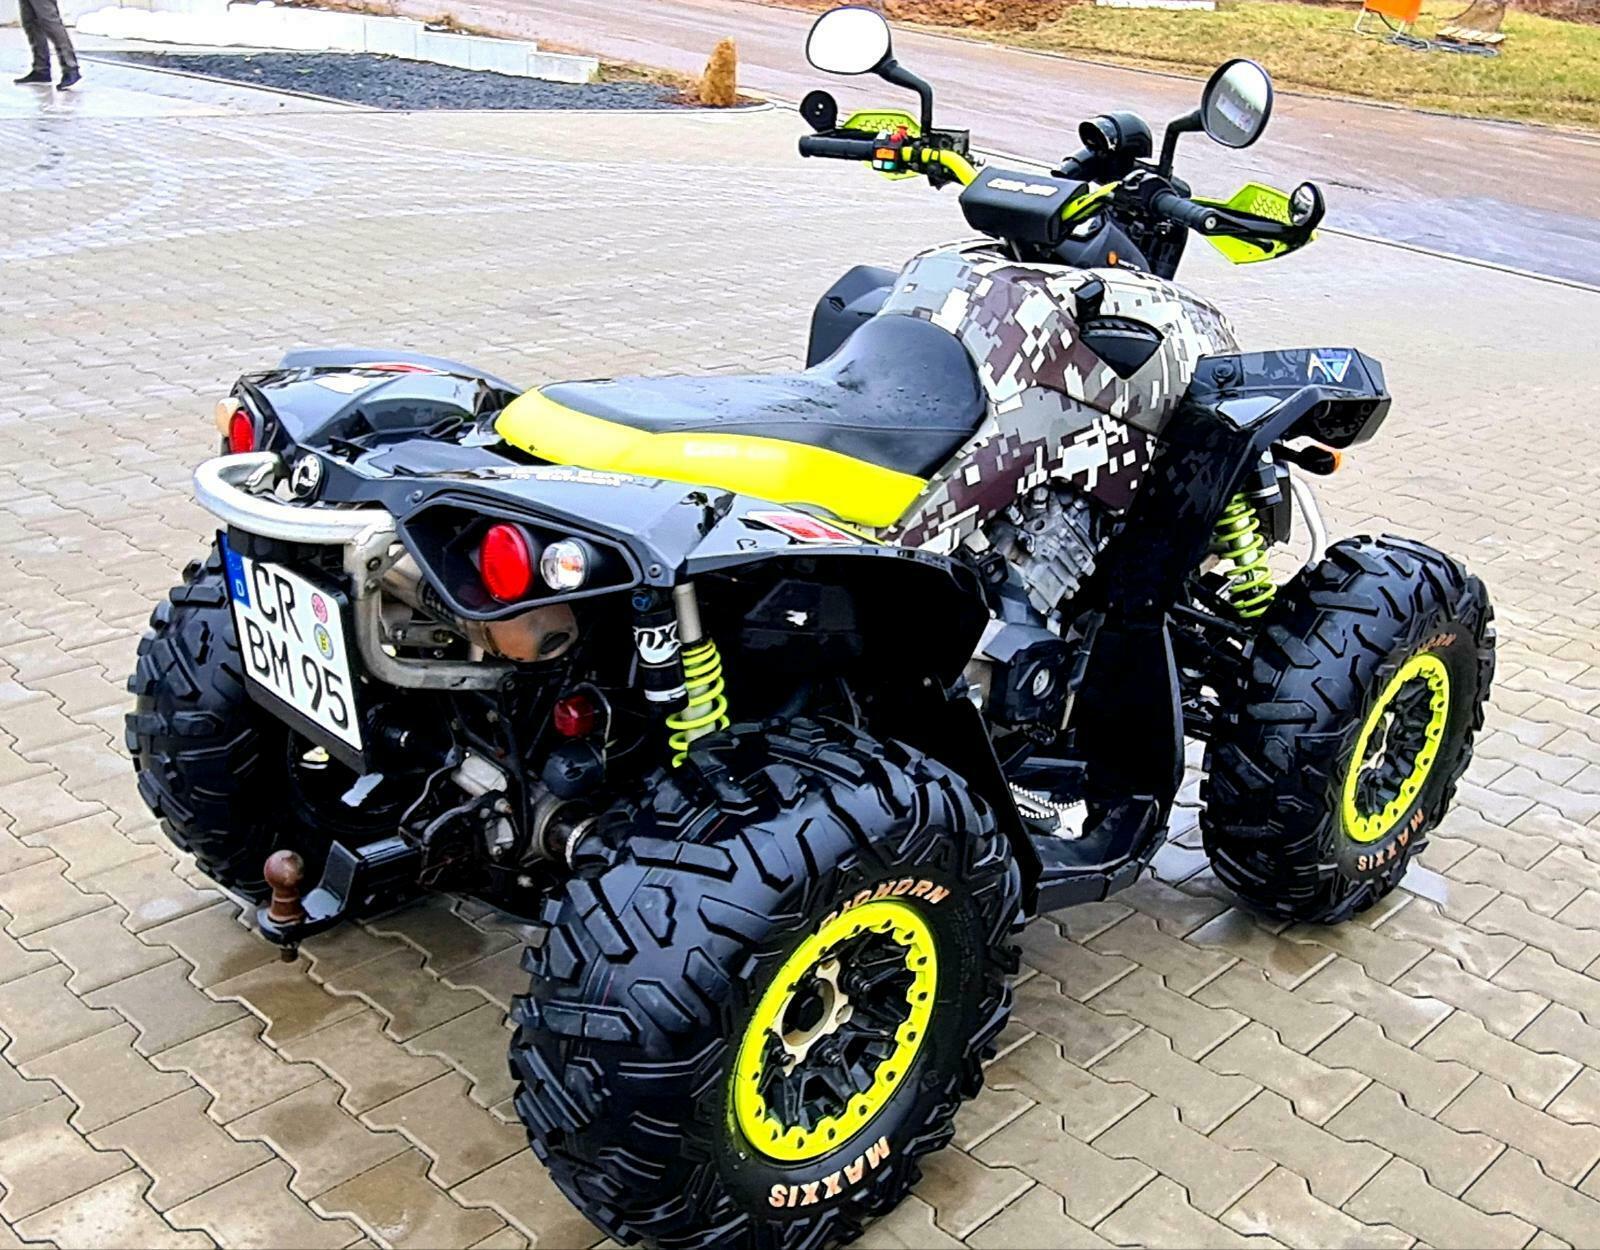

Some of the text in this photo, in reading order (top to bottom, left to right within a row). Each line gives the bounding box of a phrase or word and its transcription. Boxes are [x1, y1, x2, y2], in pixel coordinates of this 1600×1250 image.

[235, 578, 245, 598] D
[252, 561, 304, 643] CR
[244, 616, 295, 699] BM
[301, 654, 349, 731] 95
[1357, 808, 1424, 871] MAXXIS
[768, 1135, 891, 1208] MAXXIS
